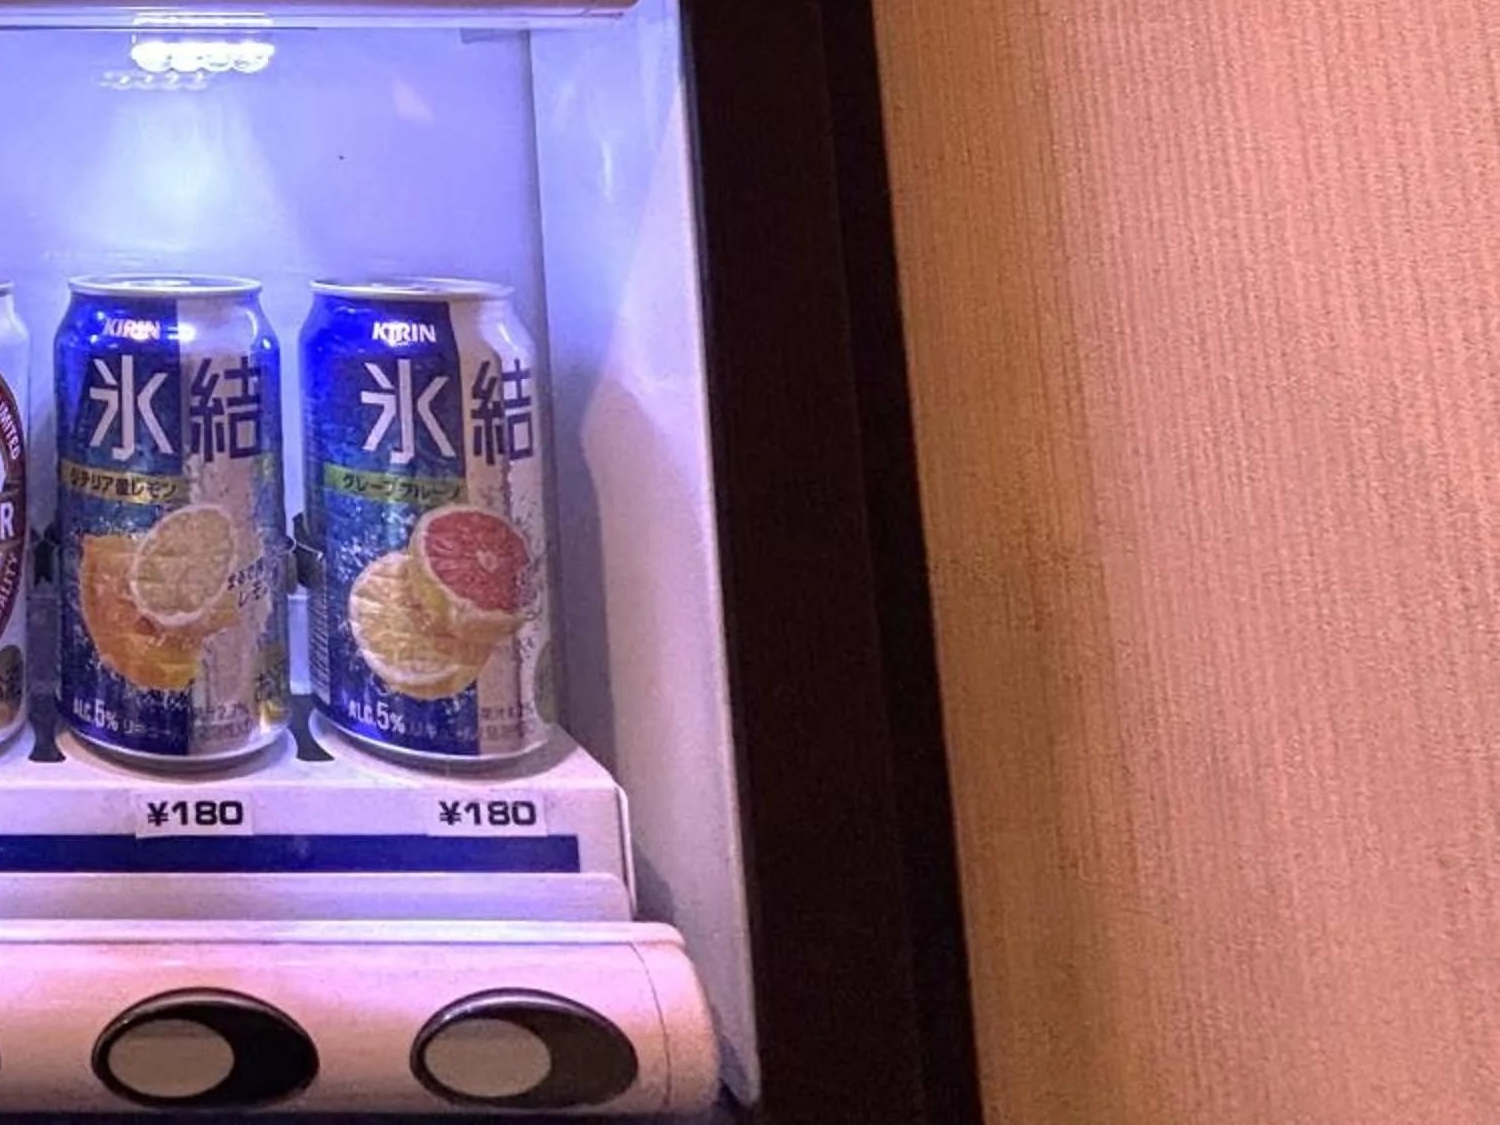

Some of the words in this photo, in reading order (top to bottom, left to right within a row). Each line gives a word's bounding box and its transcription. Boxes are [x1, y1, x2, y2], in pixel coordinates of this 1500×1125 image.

[102, 317, 161, 340] KIRIN
[371, 321, 437, 343] KIRIN
[88, 353, 262, 463] 氷結
[360, 358, 534, 466] 氷結
[147, 800, 244, 827] ¥180
[439, 800, 537, 827] ¥180
